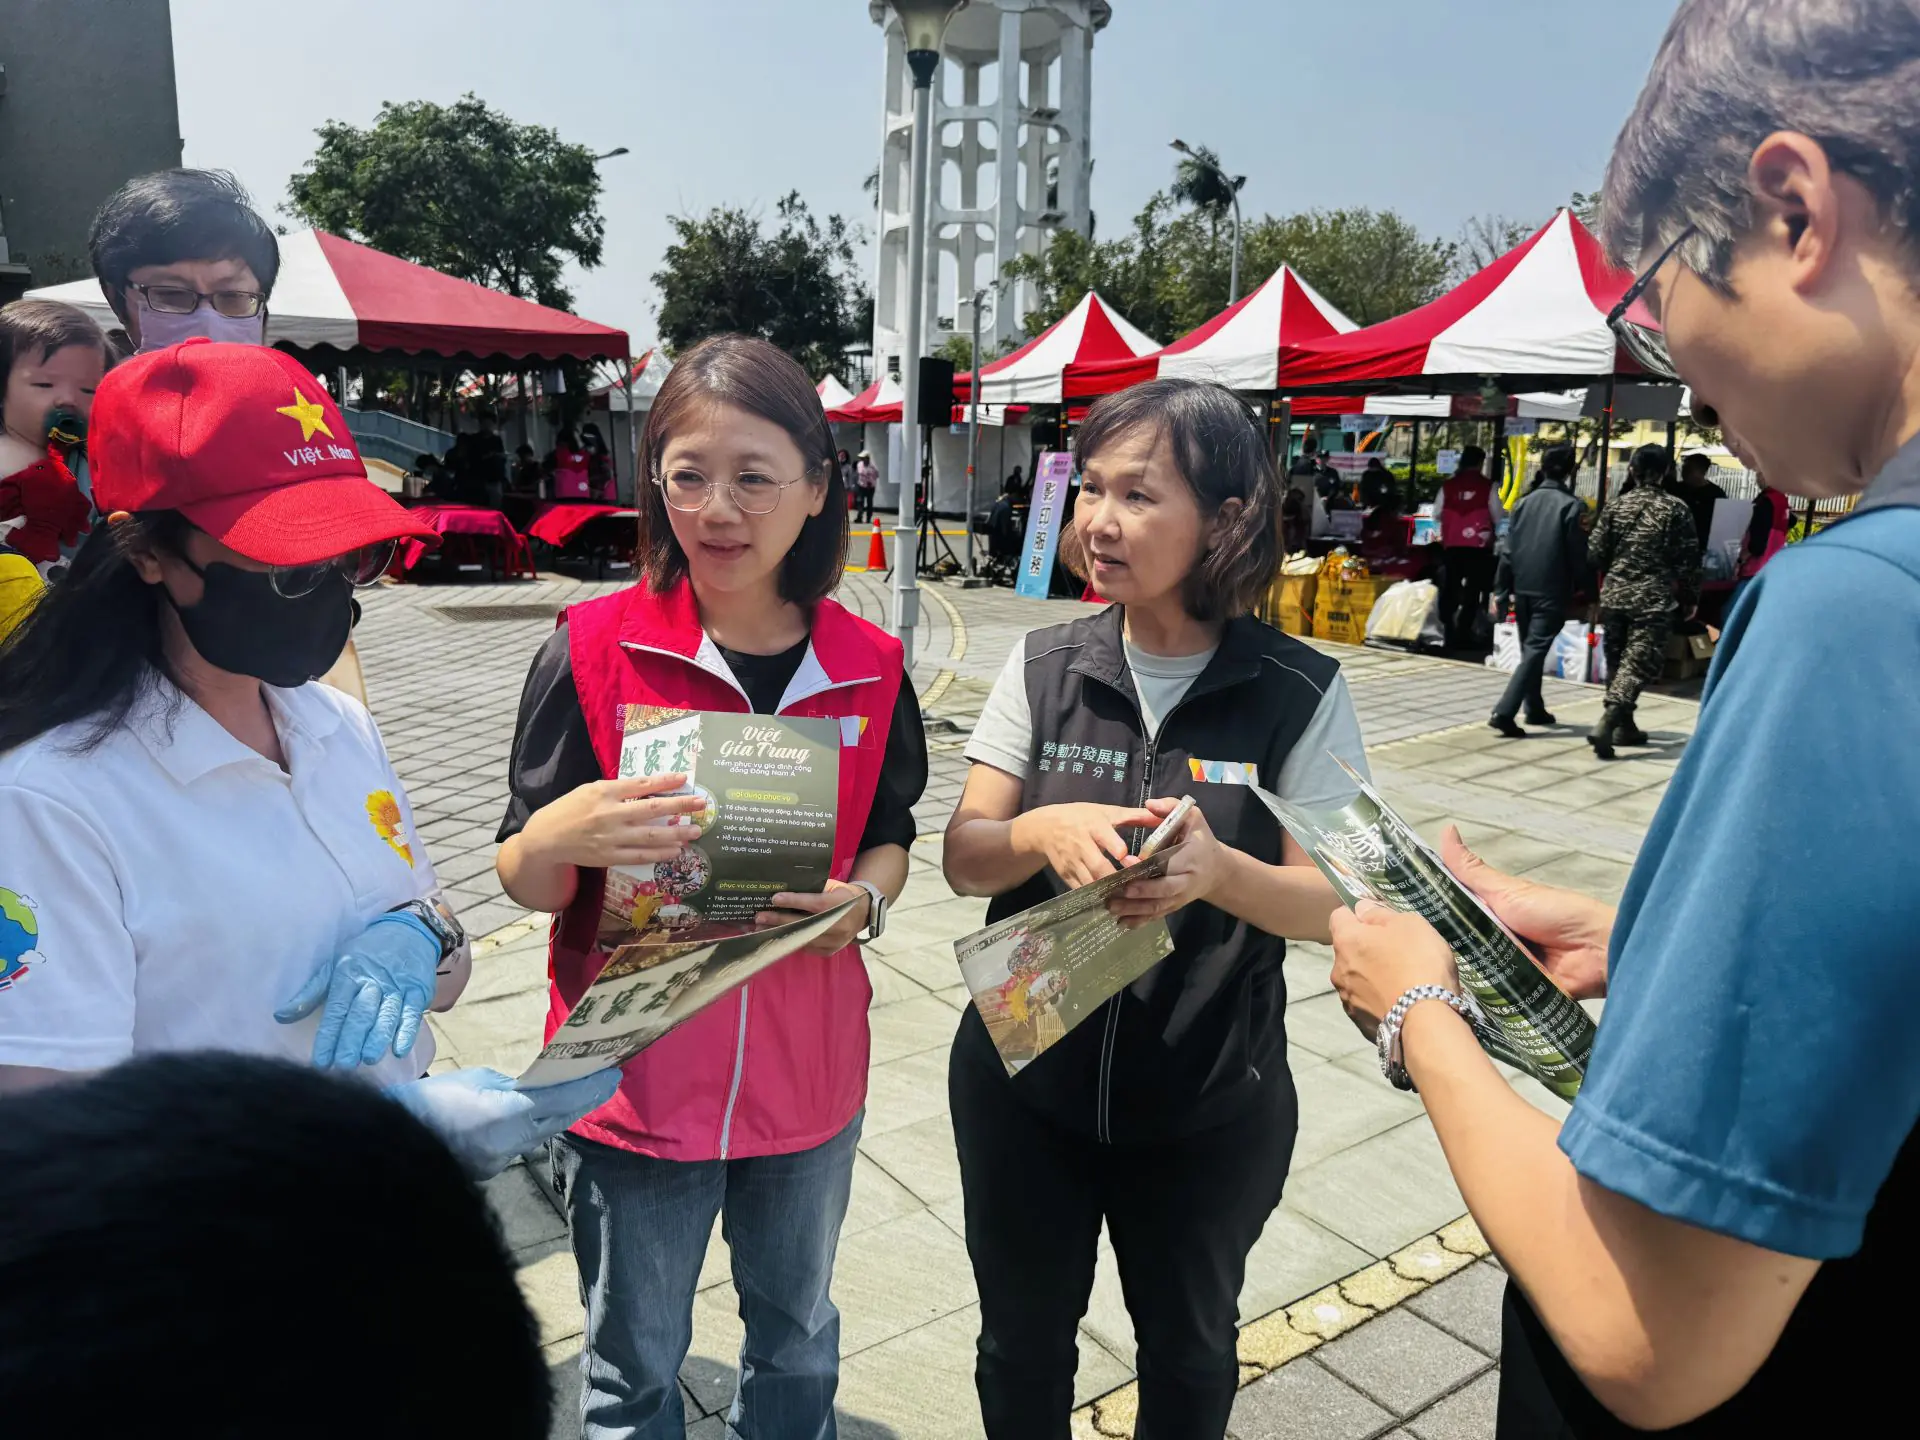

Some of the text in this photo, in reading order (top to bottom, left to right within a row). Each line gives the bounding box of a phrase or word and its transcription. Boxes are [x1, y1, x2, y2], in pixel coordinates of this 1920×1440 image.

[283, 444, 356, 467] Việt Nam
[742, 725, 783, 742] Việt
[720, 740, 811, 764] Gia Trang
[1042, 741, 1128, 769] 勞動力發展署
